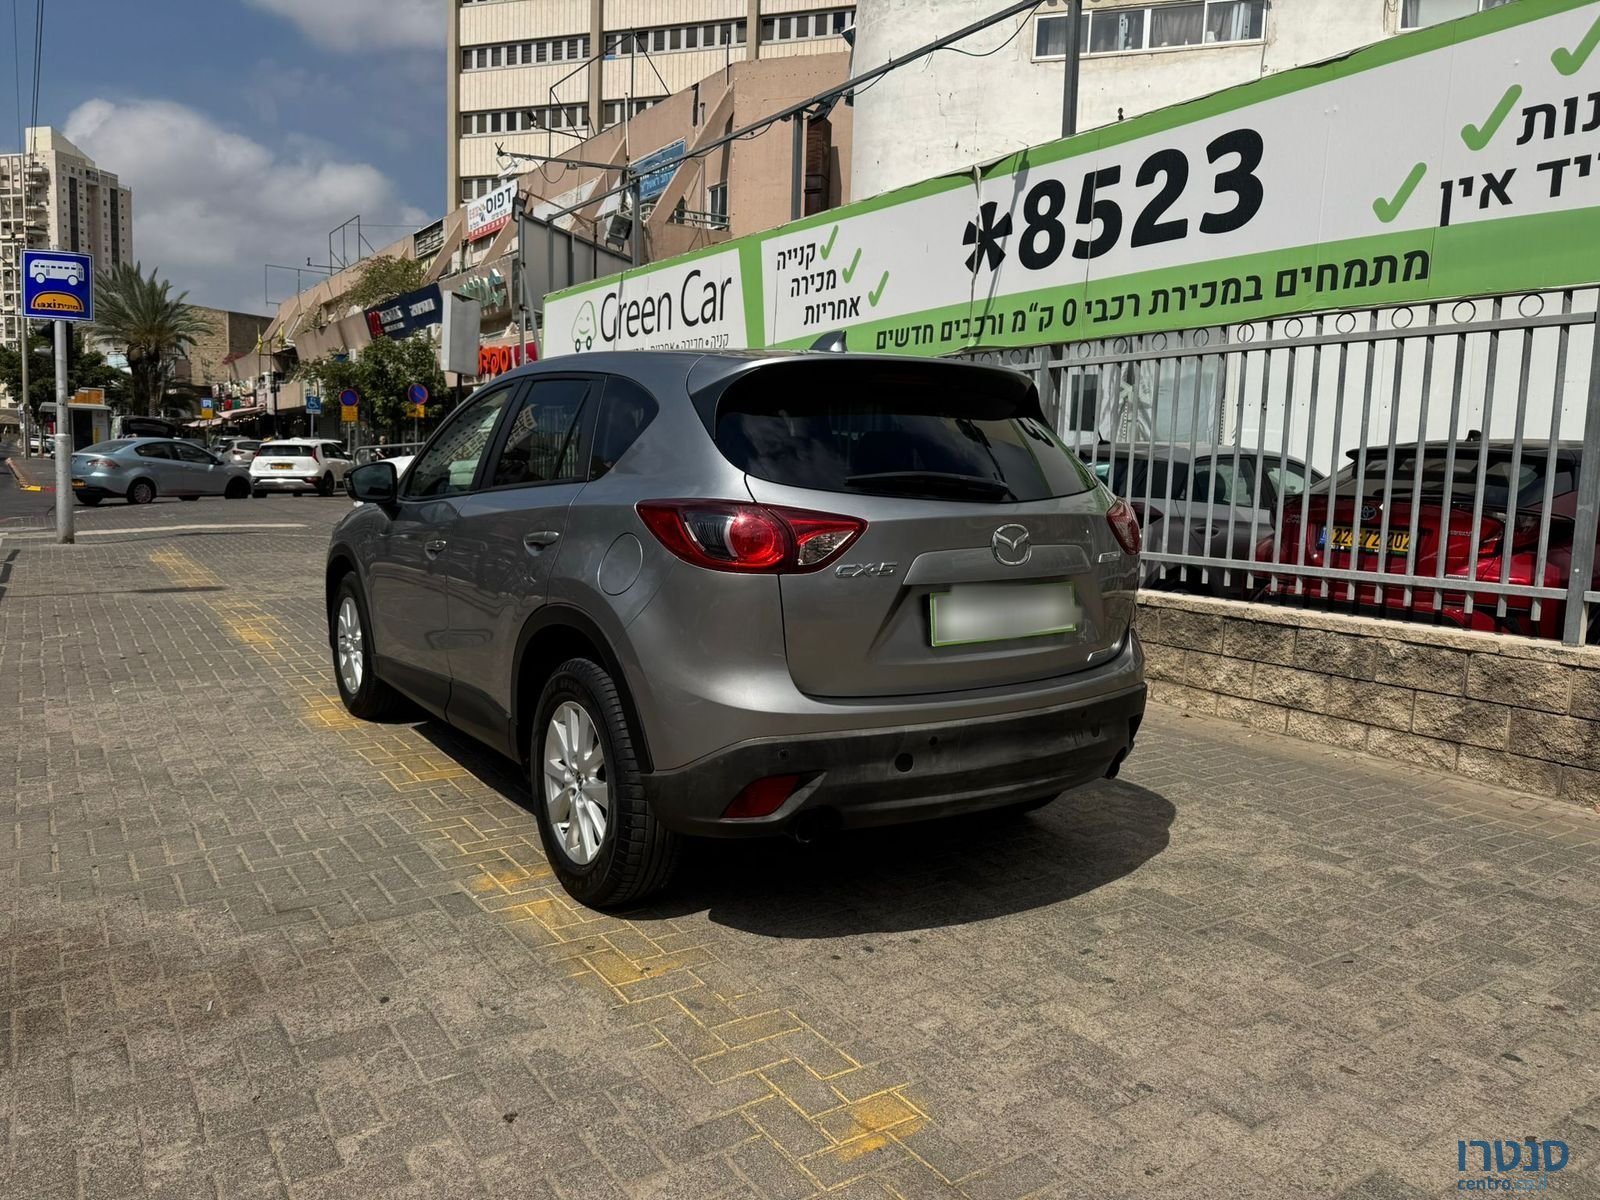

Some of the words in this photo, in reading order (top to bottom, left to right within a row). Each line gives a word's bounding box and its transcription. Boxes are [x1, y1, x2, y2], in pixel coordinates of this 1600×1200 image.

[1536, 152, 1600, 198] יד
[486, 187, 512, 214] דפוס
[1440, 168, 1518, 227] אין
[777, 243, 816, 271] קנייה
[791, 269, 837, 297] מכירה
[1275, 250, 1430, 298] מתמחים
[37, 298, 56, 308] taxi
[601, 292, 671, 342] Green
[681, 269, 732, 327] Car
[1085, 293, 1140, 323] רכבי
[1148, 275, 1263, 315] במכירת
[804, 296, 861, 325] אחריות
[1062, 298, 1077, 326] 0
[876, 324, 934, 350] חדשים
[940, 313, 1003, 342] ורכבים
[835, 562, 898, 578] CX-5
